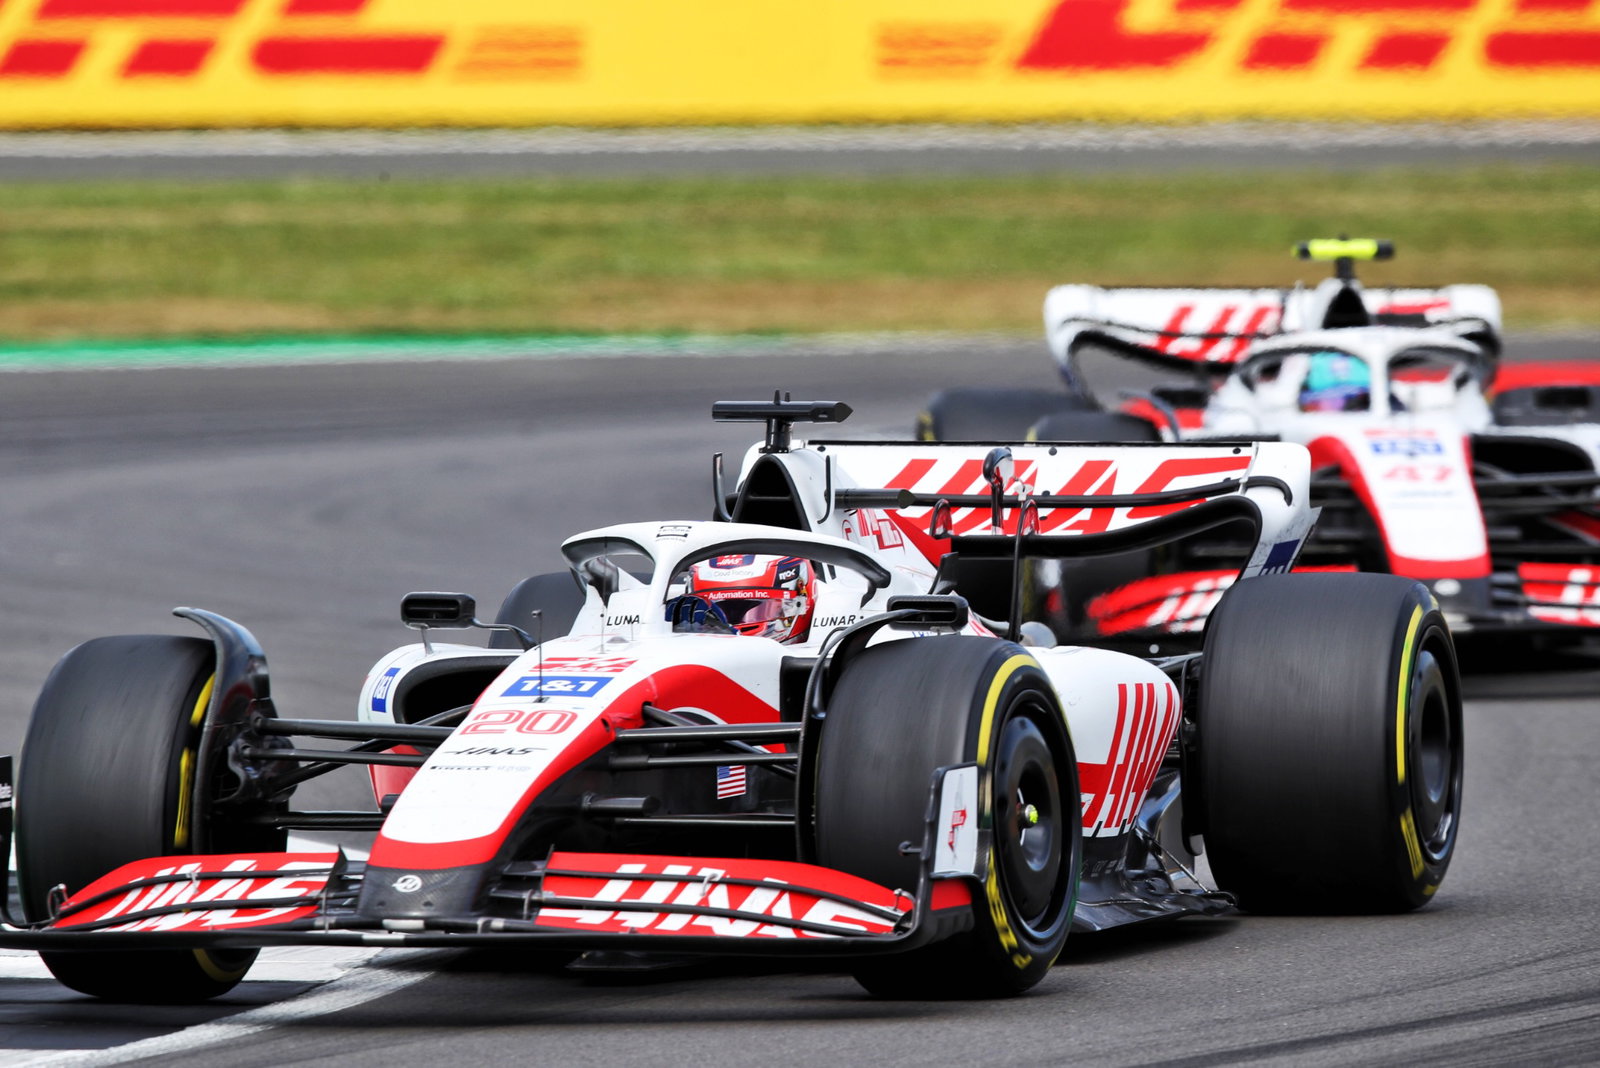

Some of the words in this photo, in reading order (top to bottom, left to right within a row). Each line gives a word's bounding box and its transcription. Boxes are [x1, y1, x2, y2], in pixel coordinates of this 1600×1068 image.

[708, 592, 752, 600] Automation
[813, 614, 856, 628] LUNAR
[520, 680, 598, 692] 1&1
[459, 709, 579, 735] 20
[537, 862, 898, 938] HAAS
